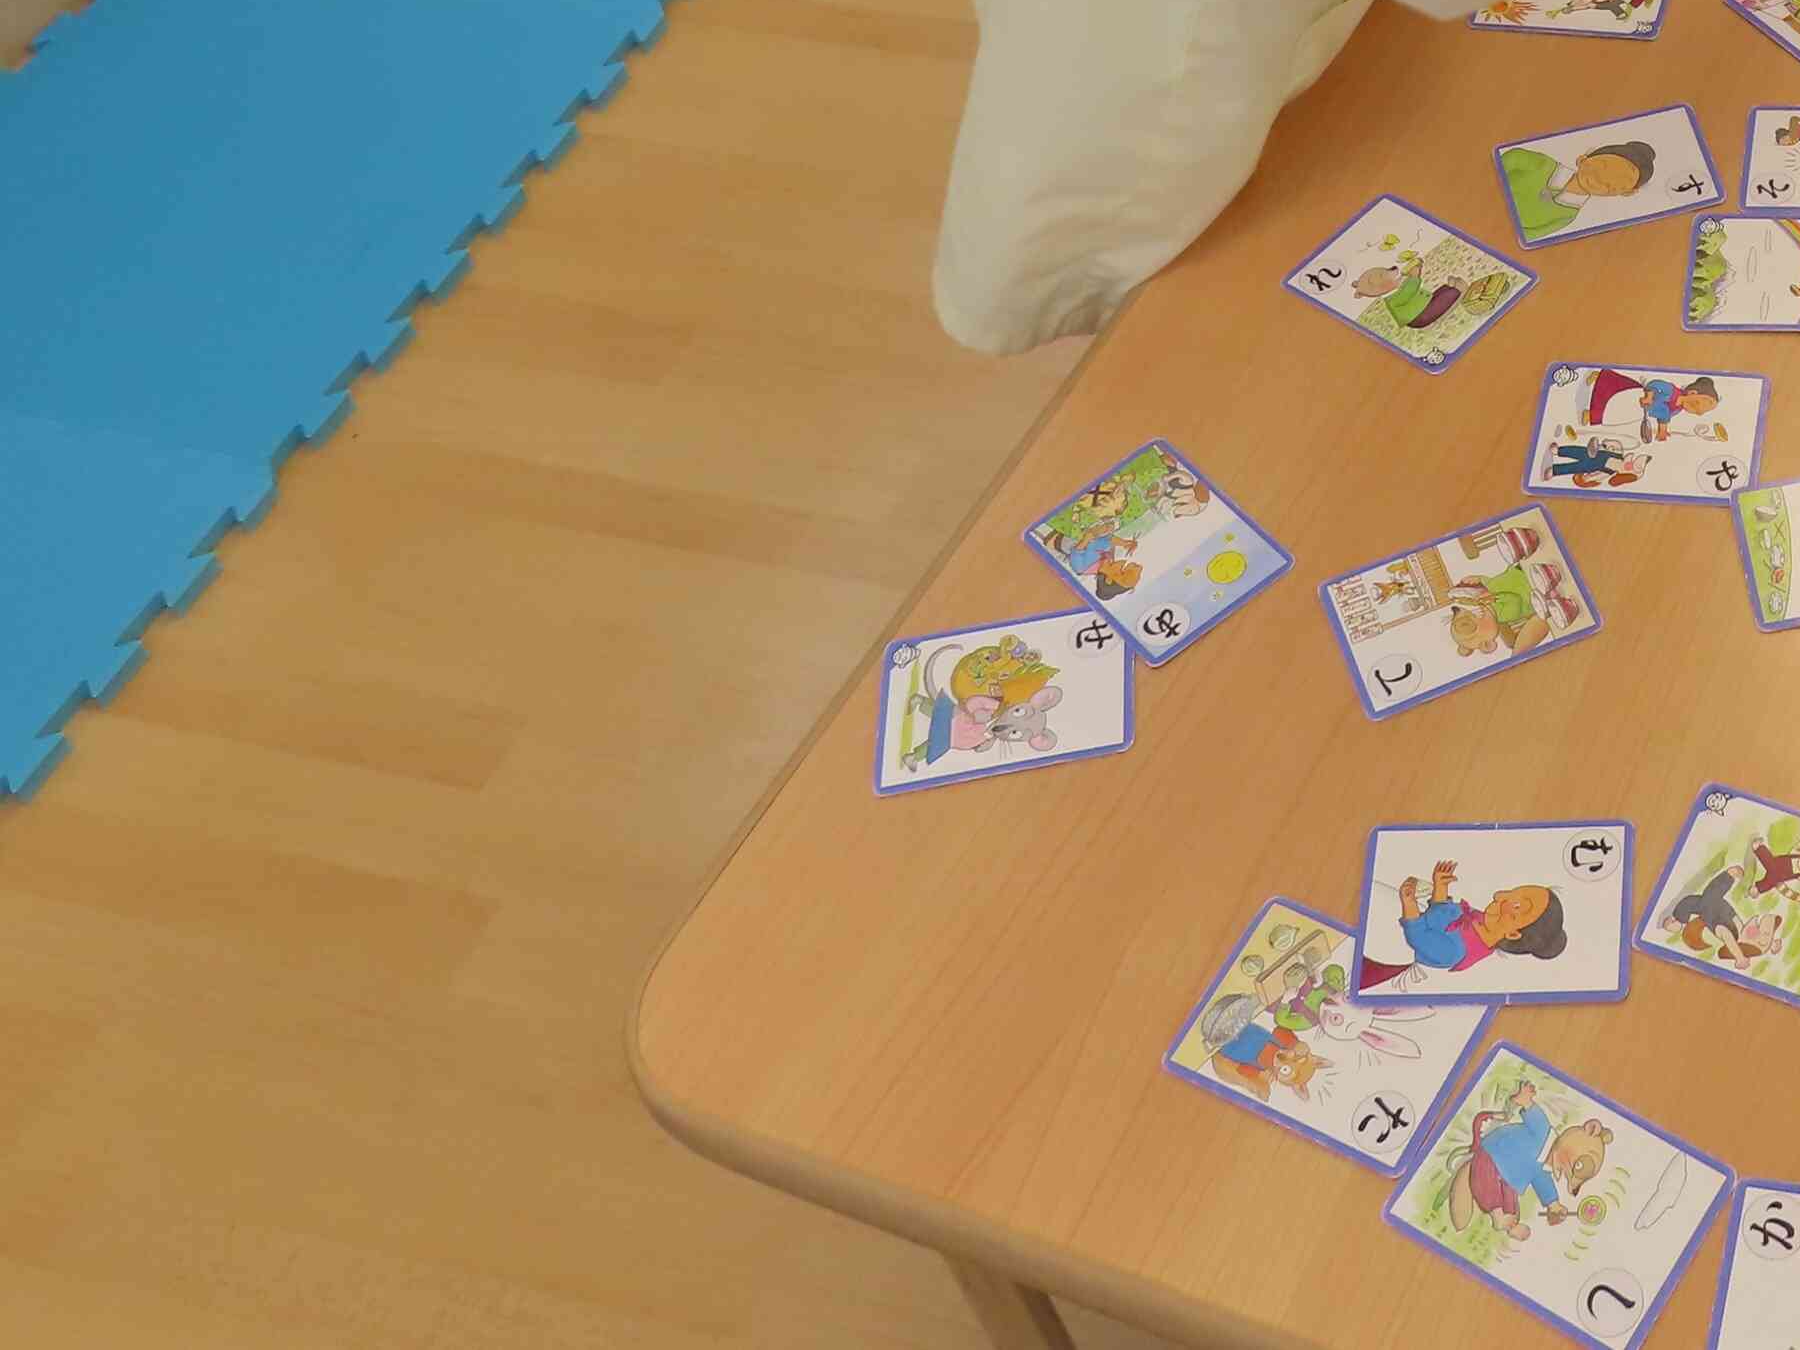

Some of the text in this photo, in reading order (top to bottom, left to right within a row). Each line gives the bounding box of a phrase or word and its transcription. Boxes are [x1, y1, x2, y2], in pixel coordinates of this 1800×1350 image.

[1672, 174, 1706, 195] す
[1757, 178, 1790, 199] そ
[1306, 267, 1342, 292] れ
[1706, 461, 1737, 491] や
[1077, 619, 1114, 650] せ
[1143, 609, 1179, 638] あ
[1375, 663, 1412, 696] て
[1571, 838, 1612, 872] む
[1358, 1097, 1408, 1143] た
[1749, 1201, 1795, 1251] か
[1587, 1285, 1635, 1320] し
